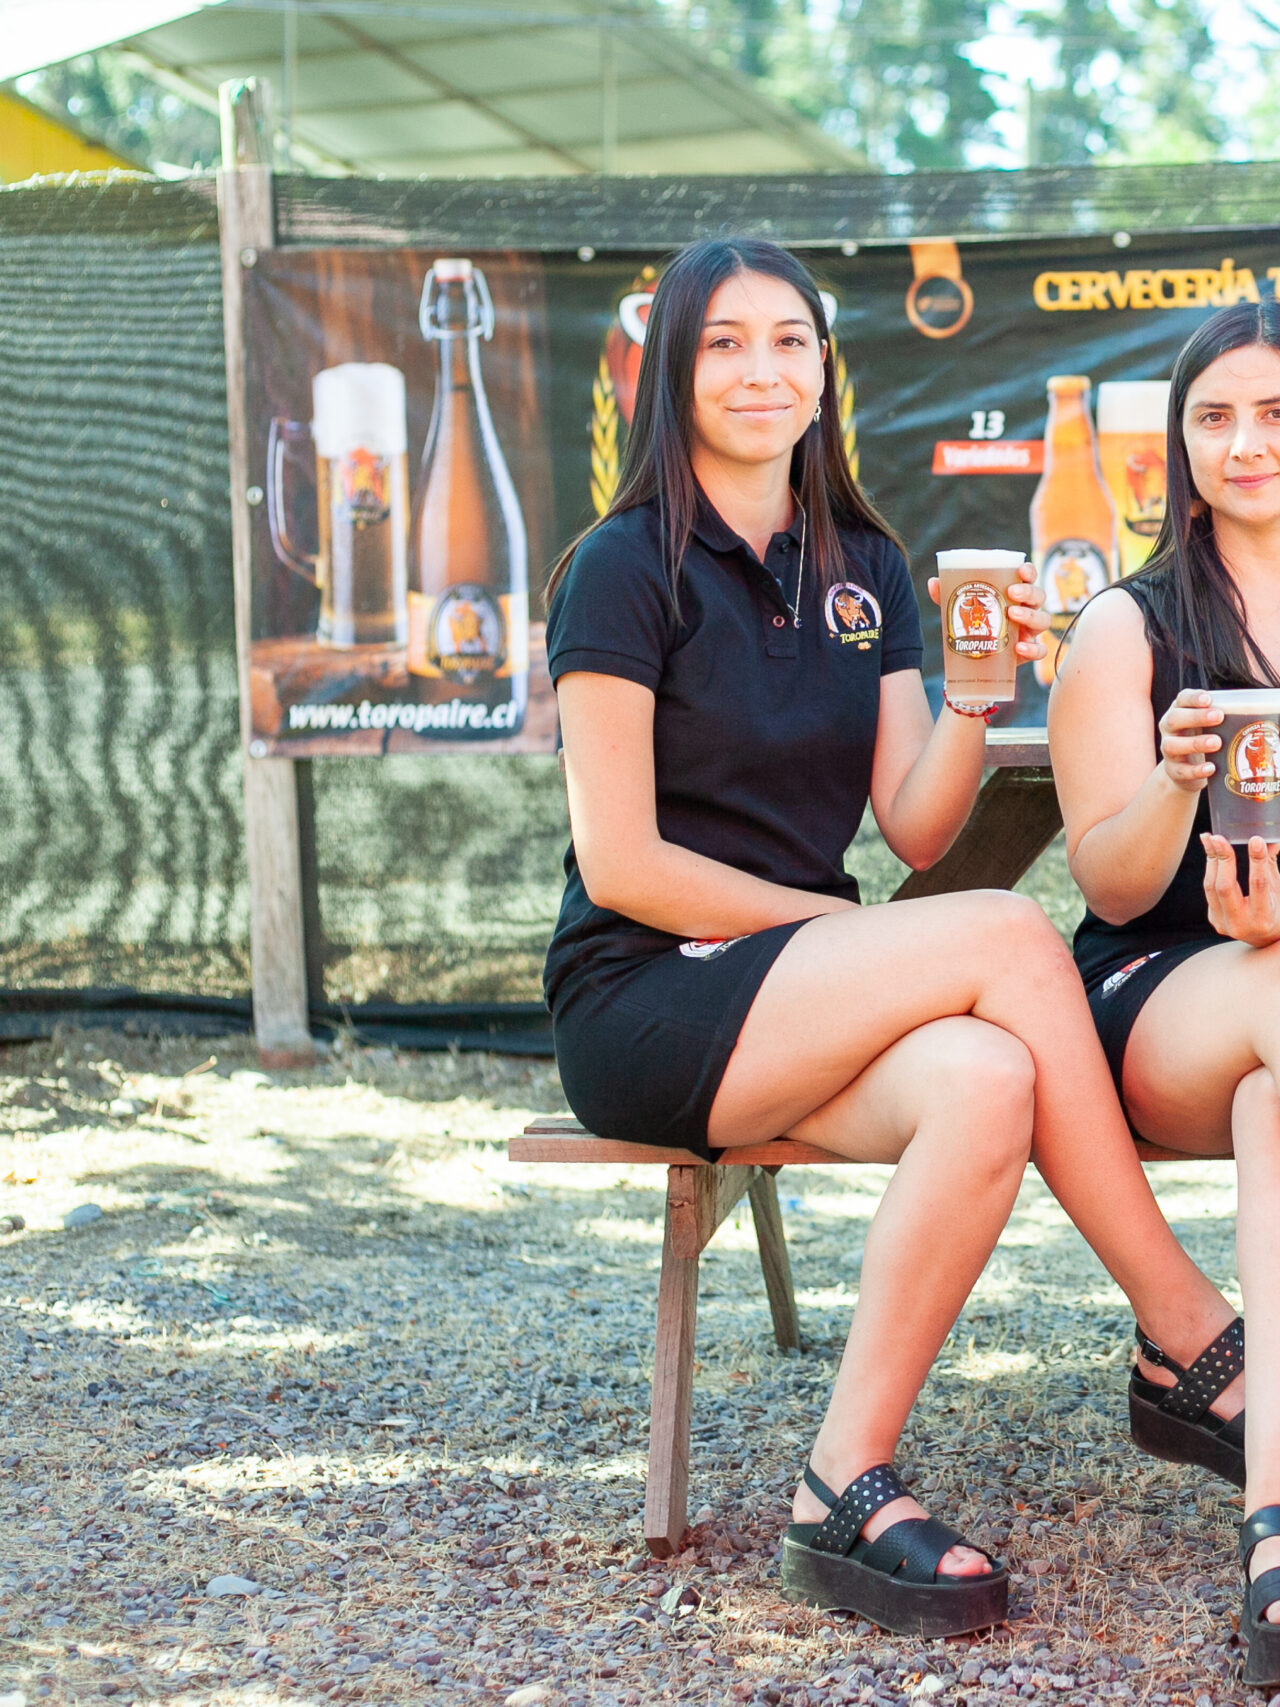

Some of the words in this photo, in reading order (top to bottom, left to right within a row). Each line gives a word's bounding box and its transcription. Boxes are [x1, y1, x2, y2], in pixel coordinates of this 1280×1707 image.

[1033, 258, 1261, 311] CERVECERÍA
[968, 410, 1006, 439] 13
[955, 639, 998, 651] TOROPAIRE
[288, 699, 518, 733] www.toropaire.cl
[1240, 780, 1280, 794] TOROPAIRE
